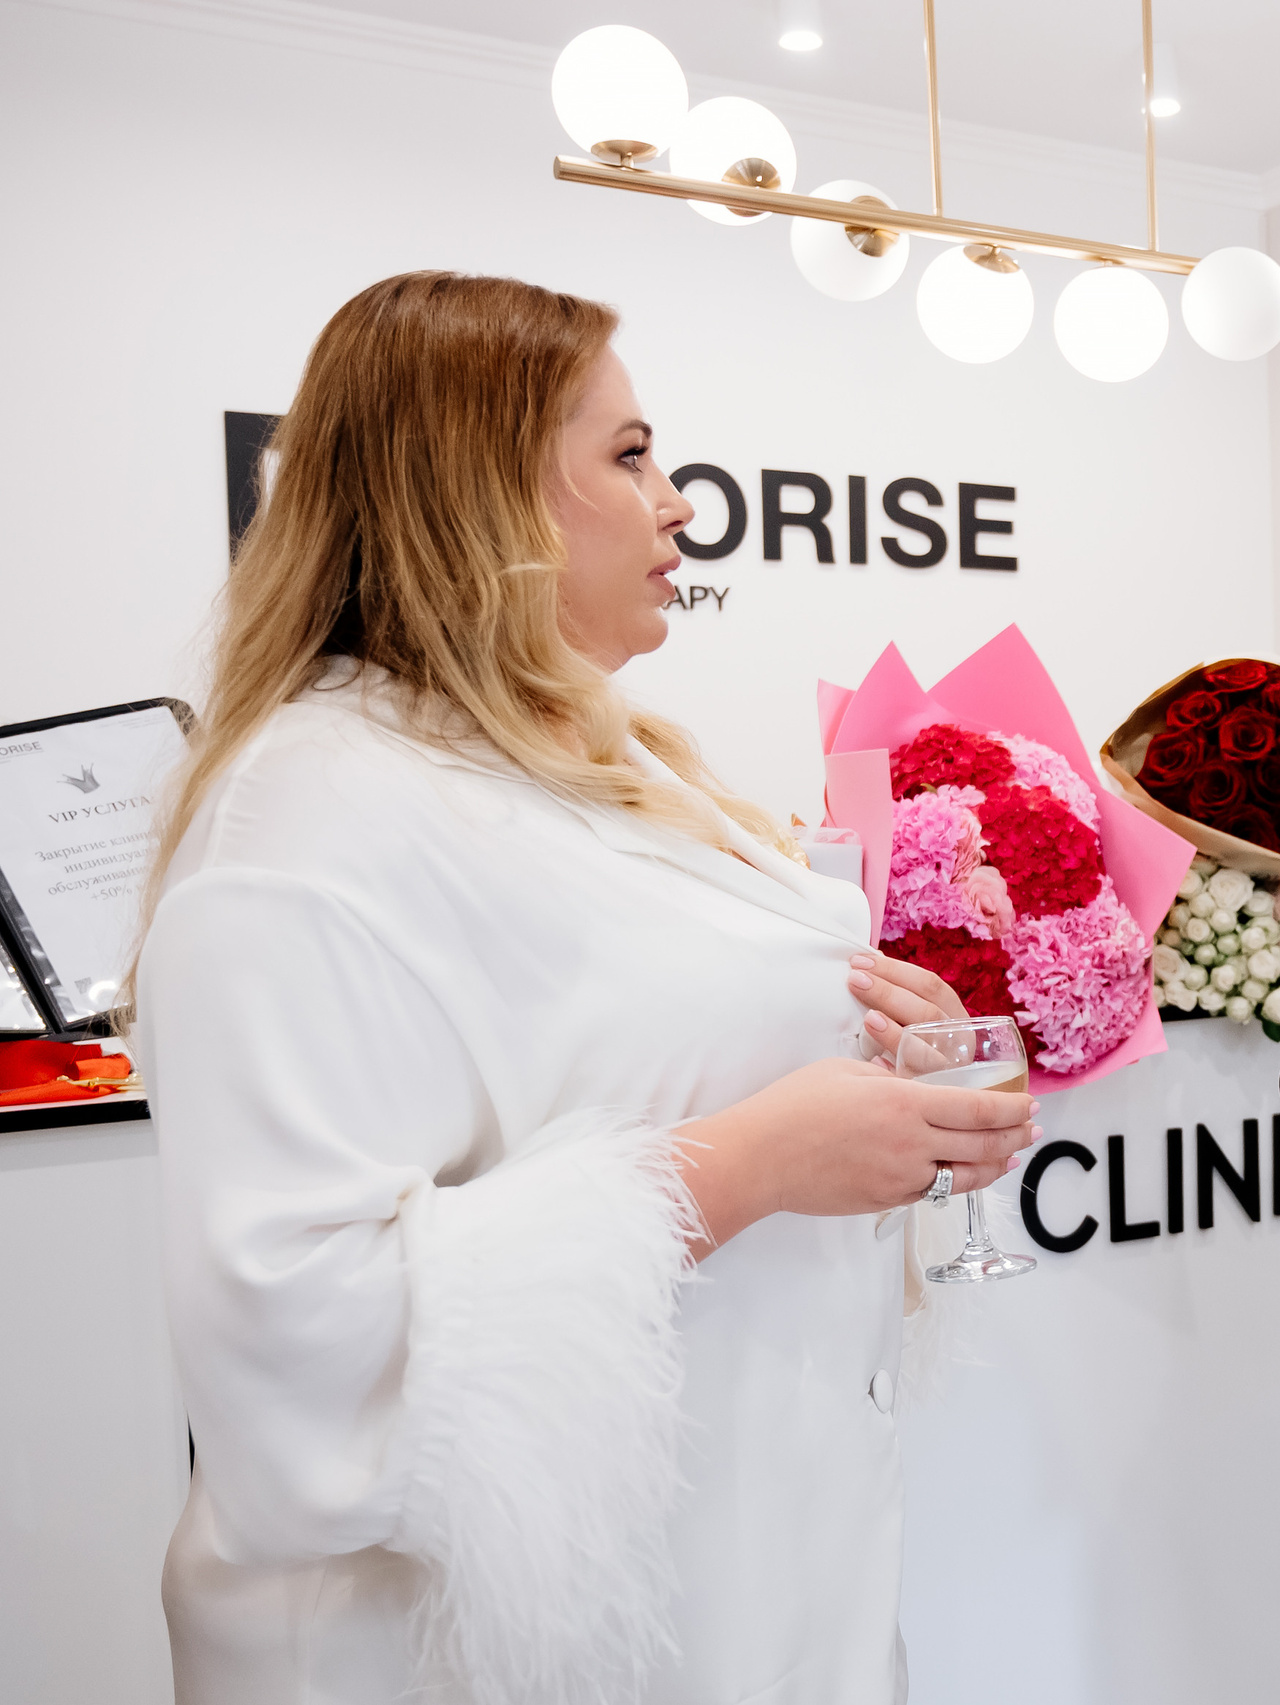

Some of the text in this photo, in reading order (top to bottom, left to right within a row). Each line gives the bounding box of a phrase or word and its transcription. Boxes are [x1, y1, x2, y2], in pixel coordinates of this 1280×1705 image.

[48, 809, 77, 824] VIP
[35, 839, 107, 862] Закрытие
[64, 848, 150, 874] индивидуал
[91, 883, 133, 902] +50%
